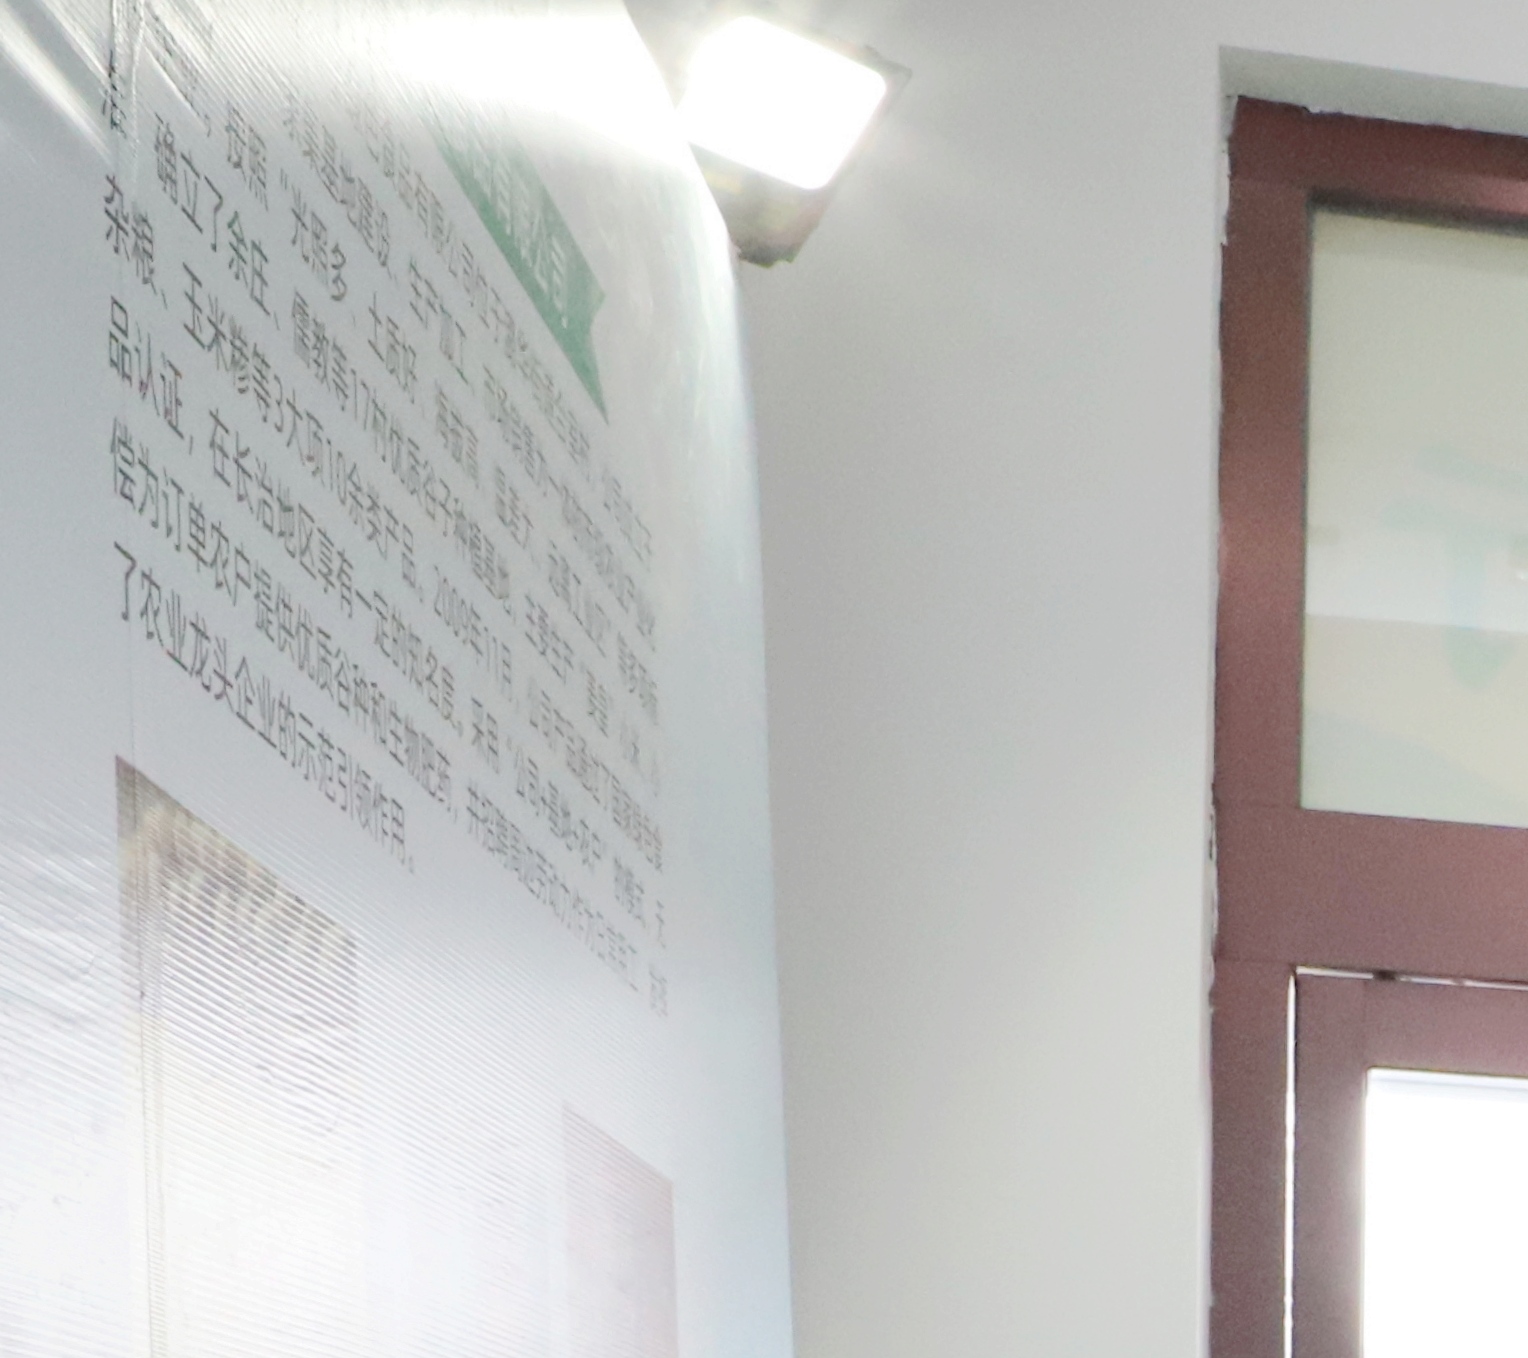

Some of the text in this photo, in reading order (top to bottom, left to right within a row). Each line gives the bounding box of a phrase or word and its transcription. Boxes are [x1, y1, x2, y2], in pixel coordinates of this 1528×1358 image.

[112, 537, 416, 874] 了农业龙头企业的示范引领作用。
